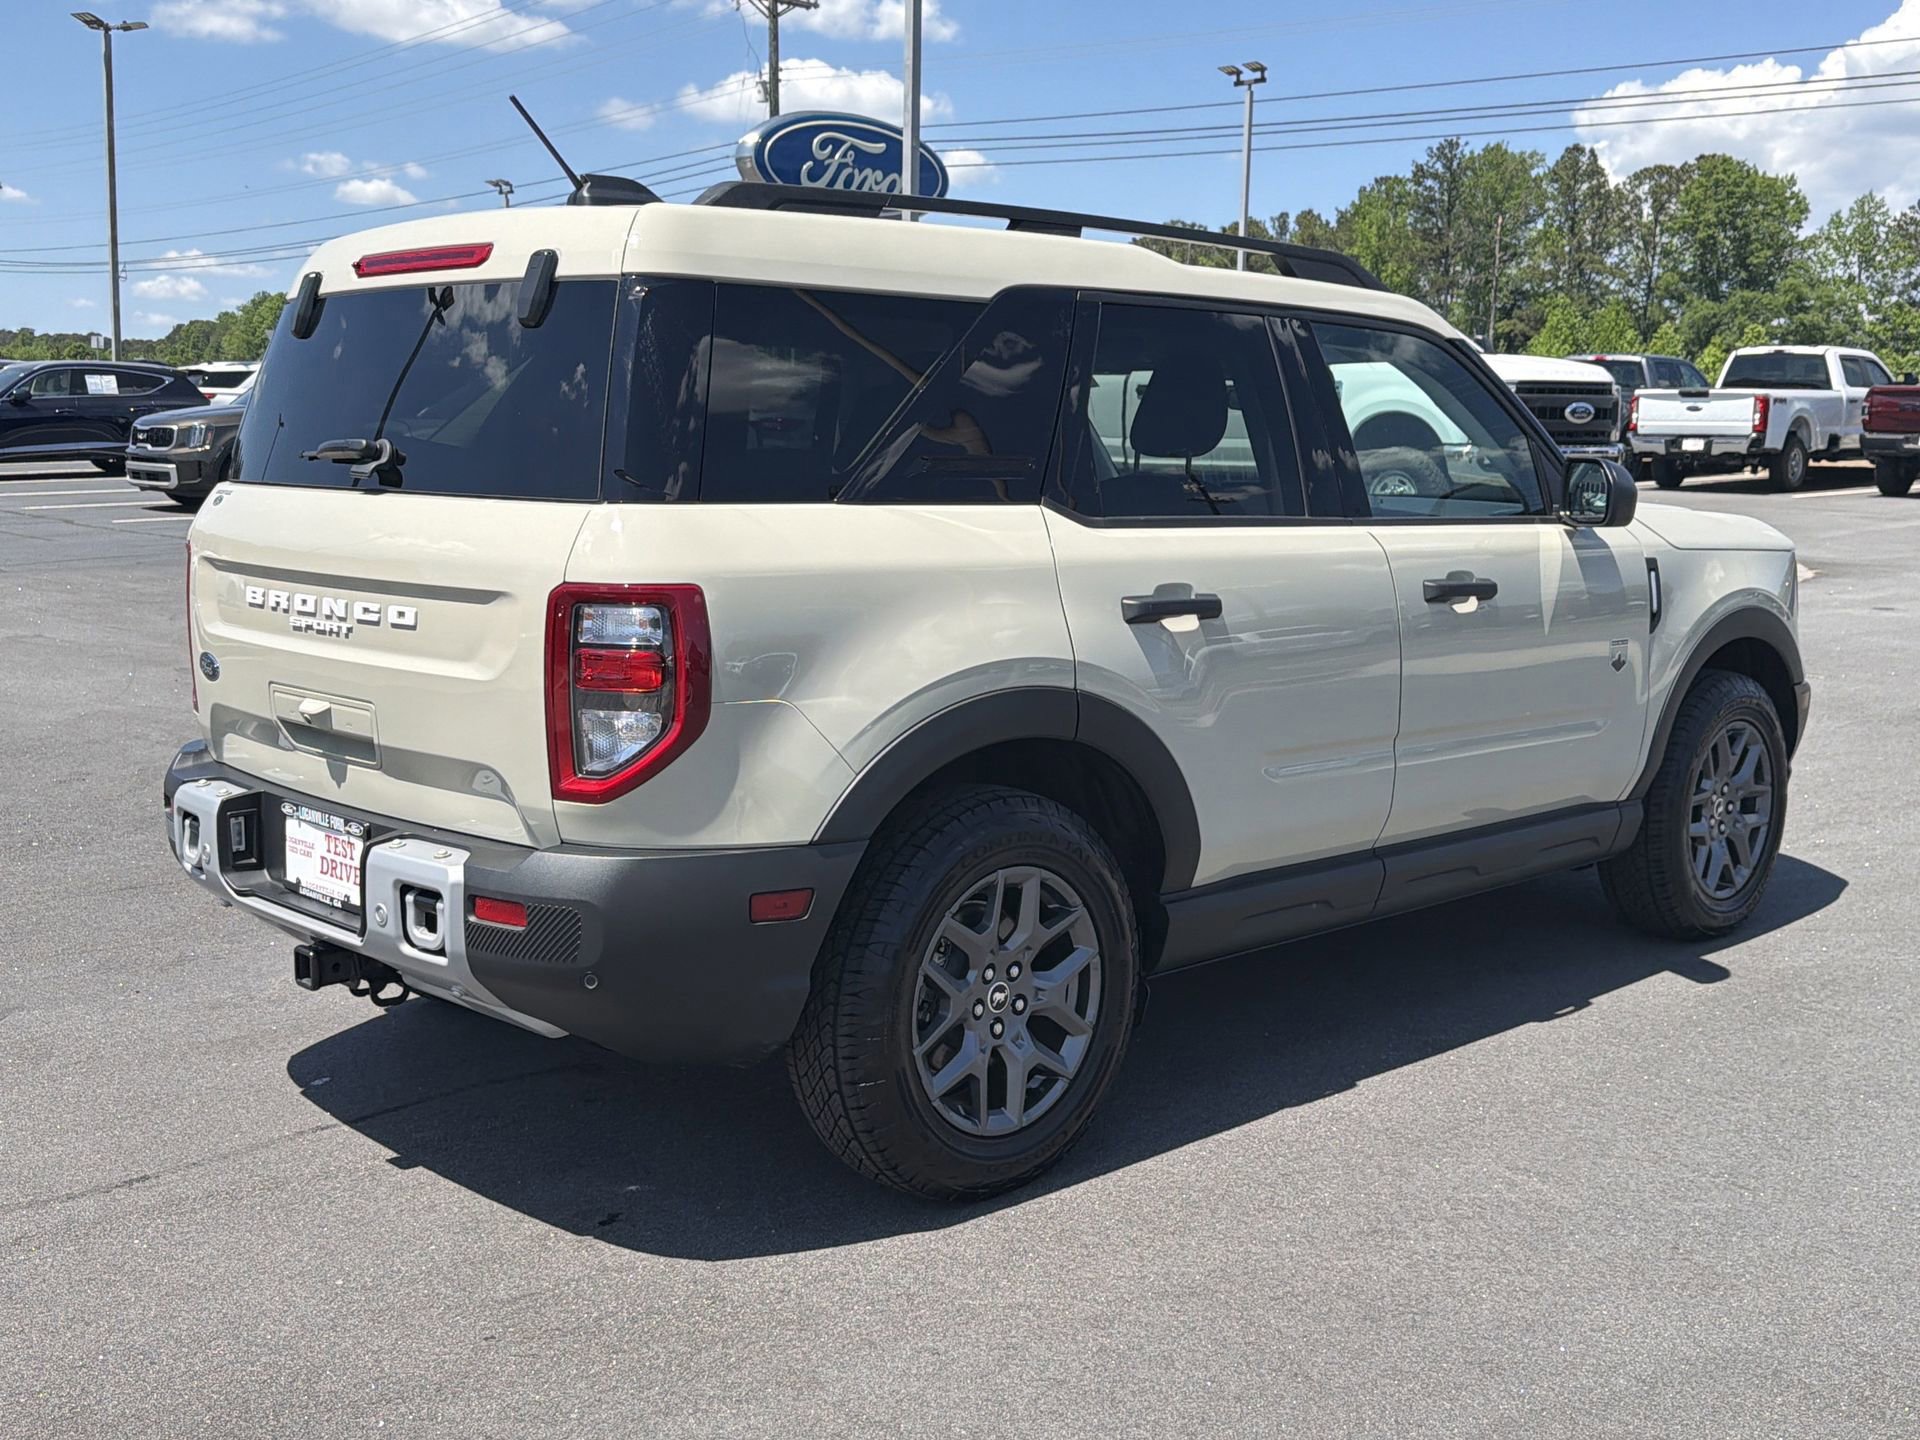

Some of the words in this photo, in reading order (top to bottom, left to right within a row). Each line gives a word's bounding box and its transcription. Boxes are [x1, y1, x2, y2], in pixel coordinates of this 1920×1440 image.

[246, 586, 417, 628] BRONCO
[289, 615, 353, 637] SPORT
[299, 806, 330, 827] LOGANVILLE
[288, 836, 315, 849] OGANVILLE
[325, 834, 355, 860] TEST
[320, 856, 360, 886] DRIVE
